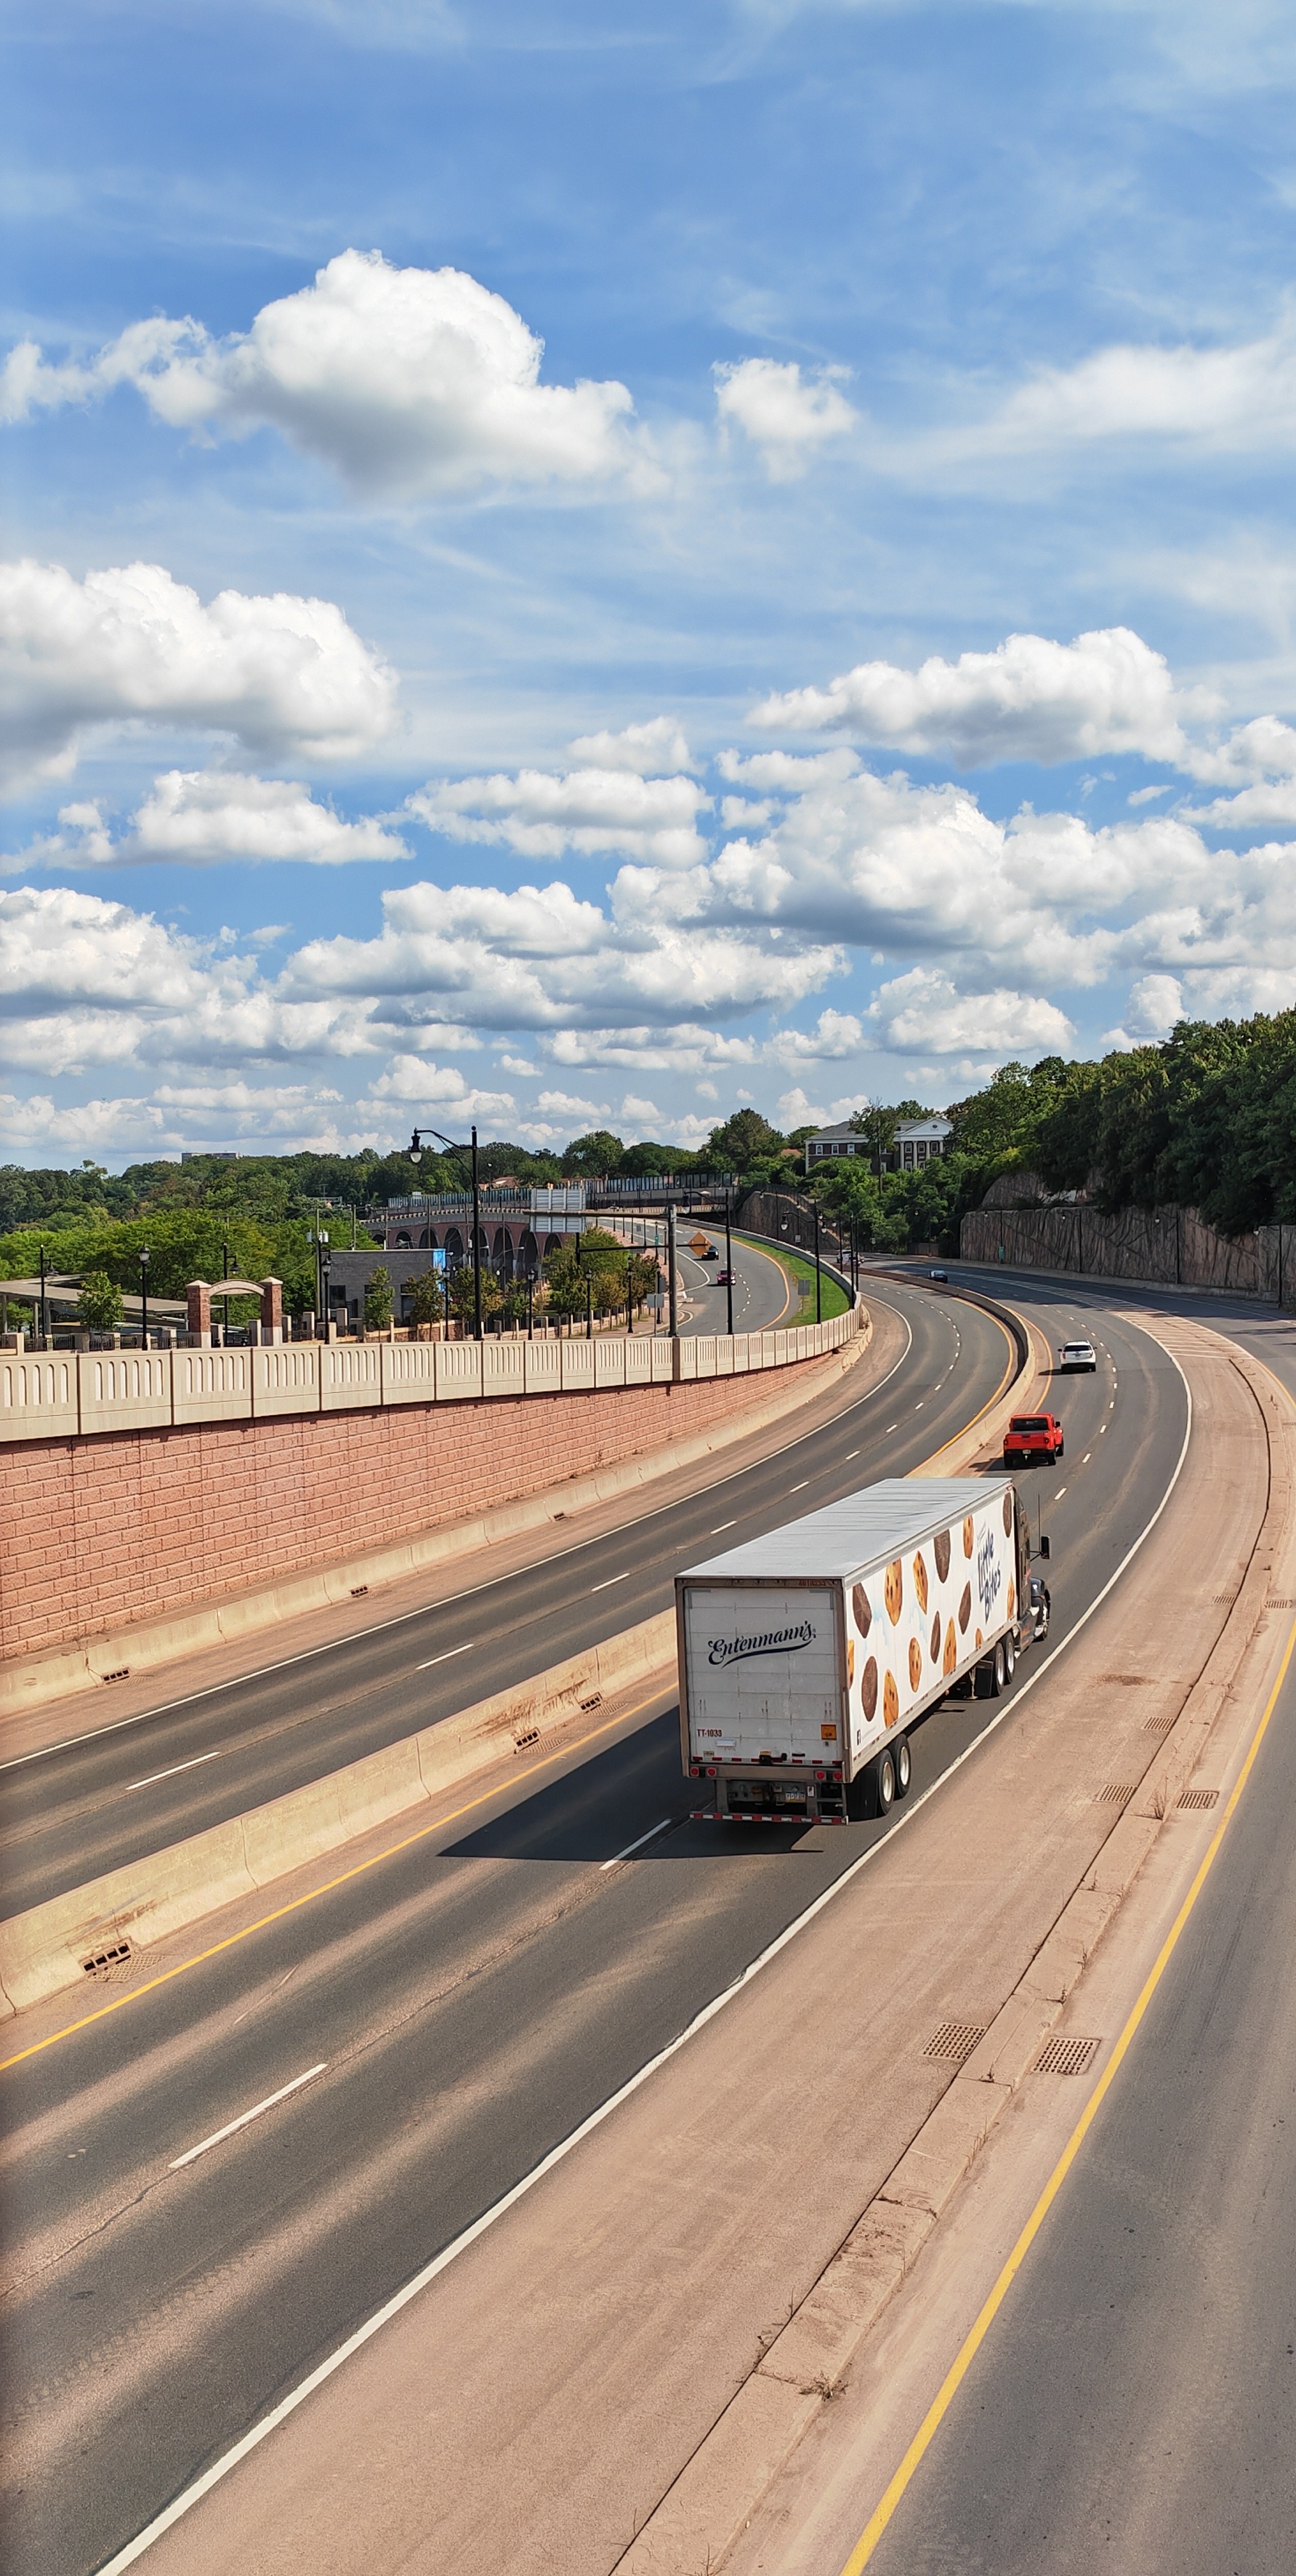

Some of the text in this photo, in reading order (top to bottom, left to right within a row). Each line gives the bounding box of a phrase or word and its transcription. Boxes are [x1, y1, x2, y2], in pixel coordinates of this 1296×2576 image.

[978, 1528, 994, 1602] Little
[984, 1560, 1000, 1625] Bites
[708, 1621, 816, 1665] Entenmann's
